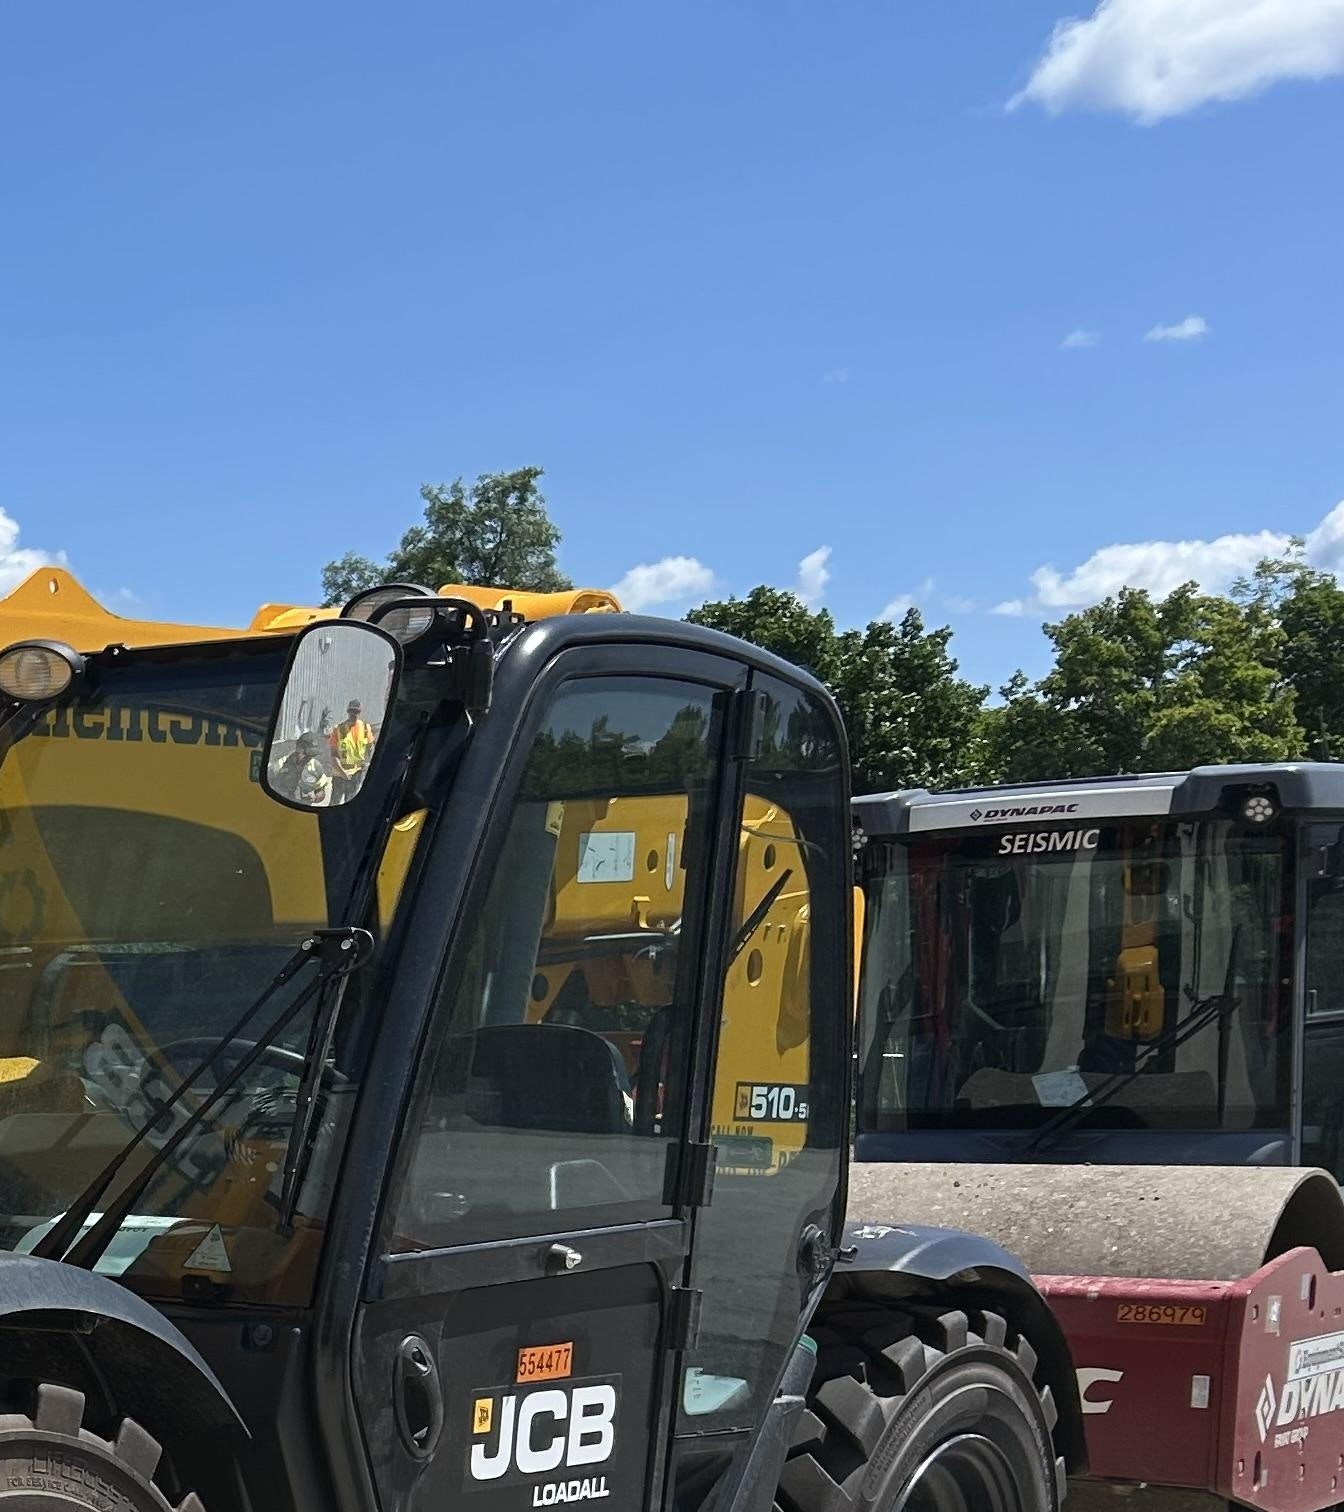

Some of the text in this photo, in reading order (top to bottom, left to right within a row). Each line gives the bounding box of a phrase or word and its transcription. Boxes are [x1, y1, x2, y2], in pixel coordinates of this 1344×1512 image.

[984, 803, 1079, 819] DYNAPAC
[998, 829, 1101, 854] SEISMIC
[1119, 1304, 1204, 1323] 286979
[519, 1348, 571, 1377] 554477
[471, 1384, 616, 1480] JCB
[533, 1476, 609, 1507] LOADALL
